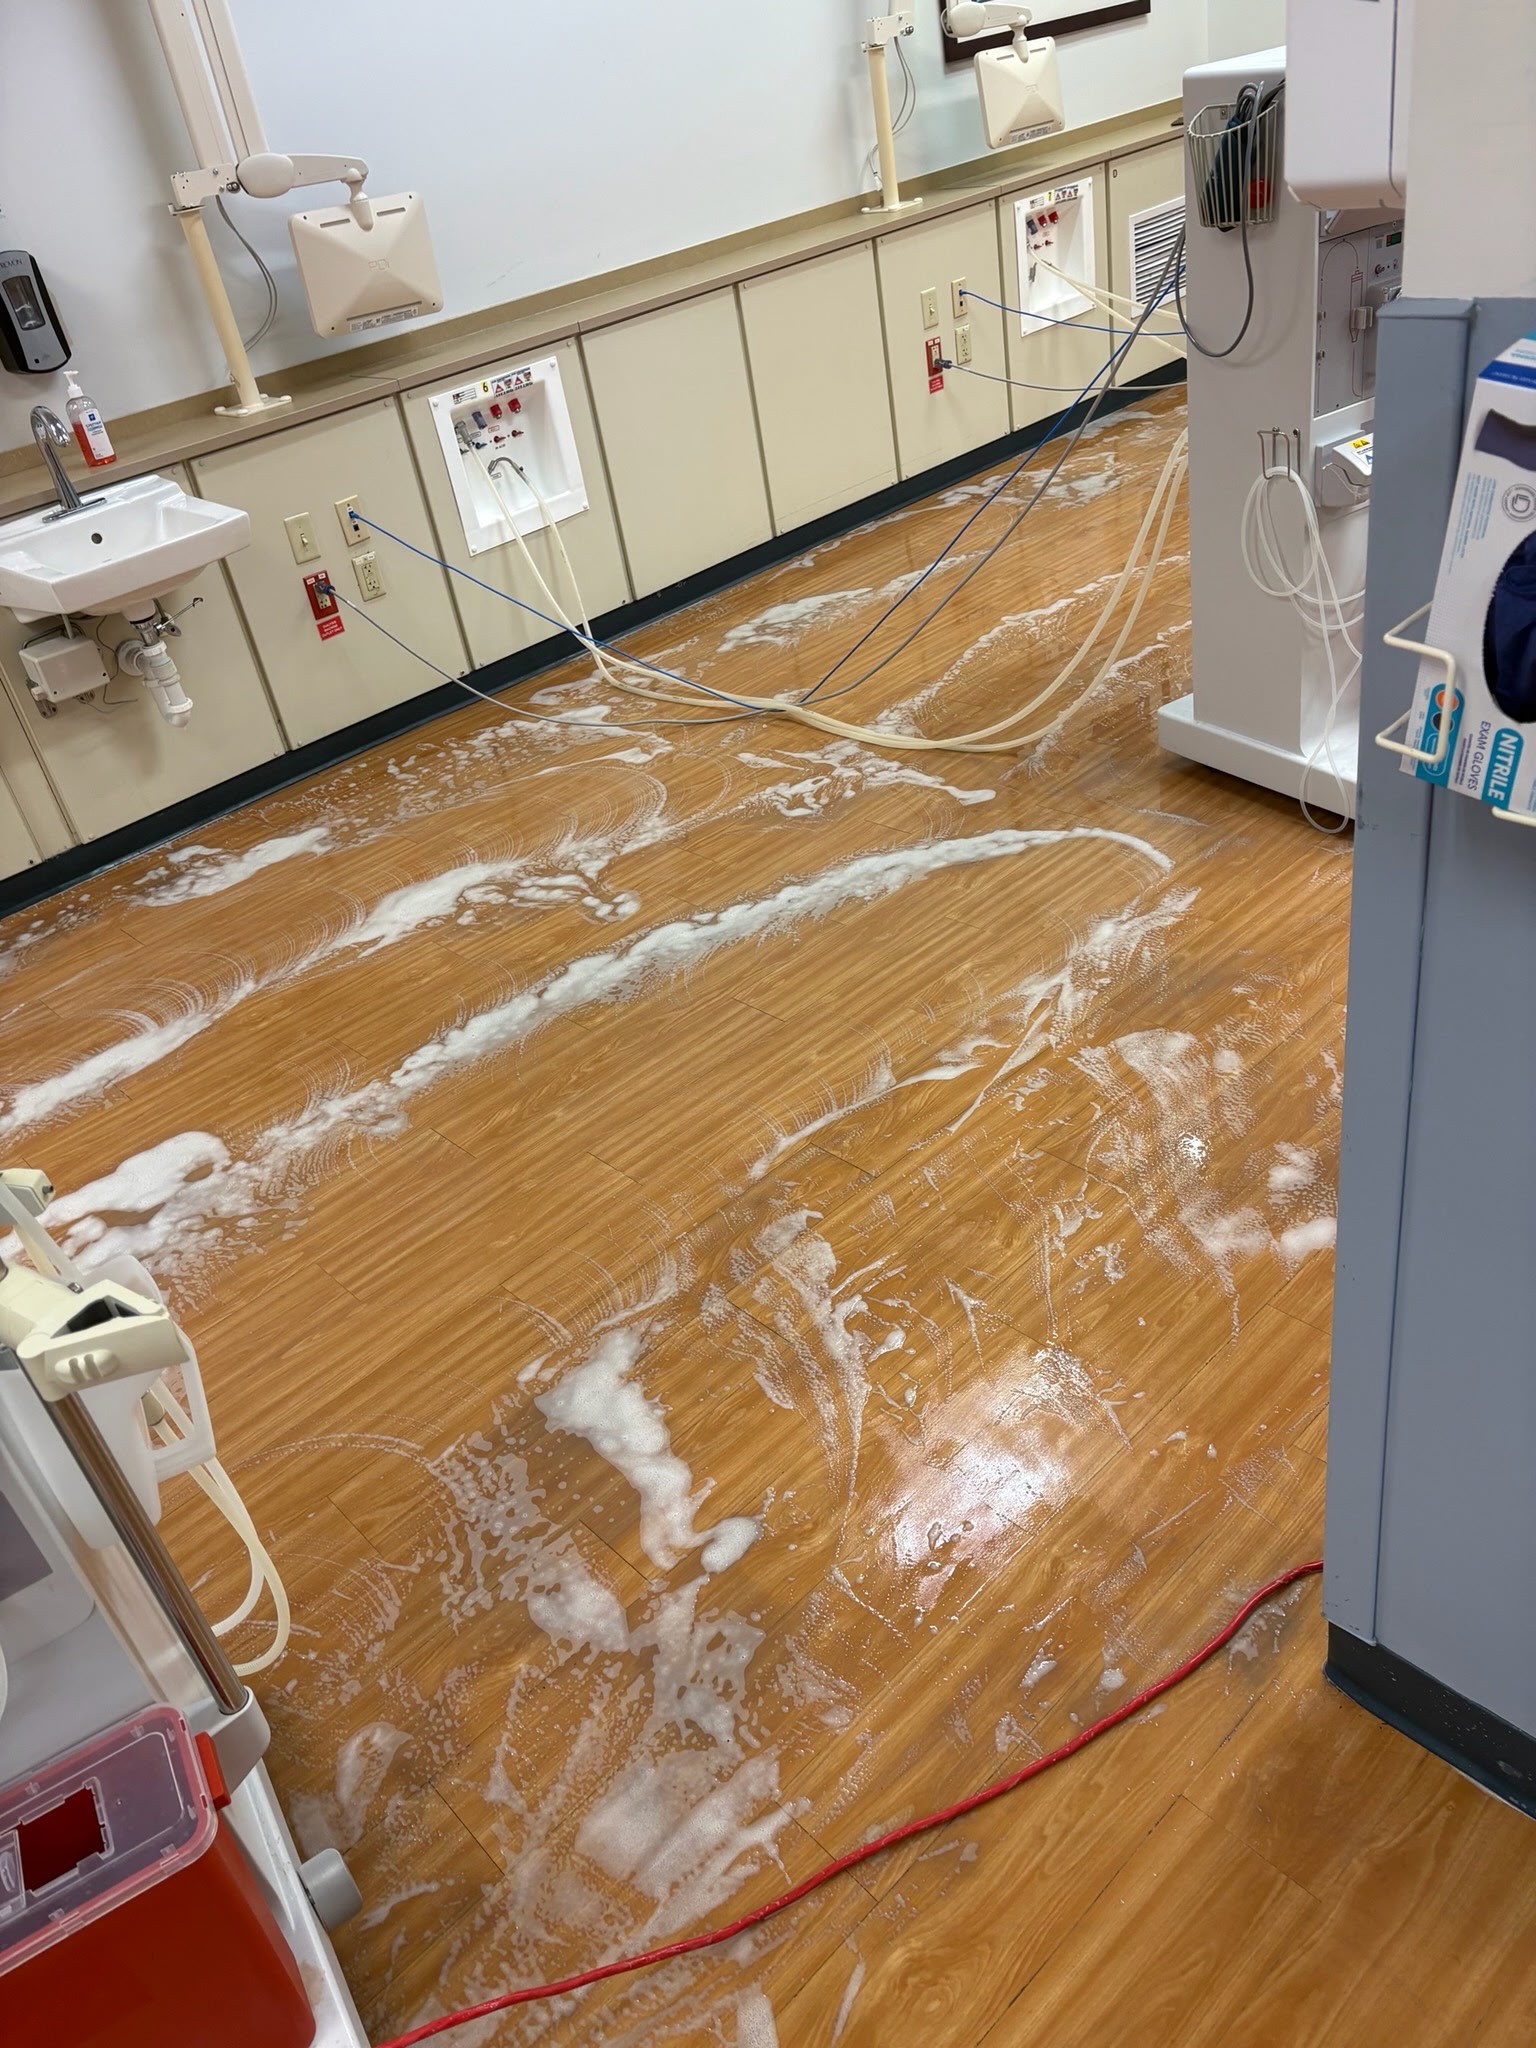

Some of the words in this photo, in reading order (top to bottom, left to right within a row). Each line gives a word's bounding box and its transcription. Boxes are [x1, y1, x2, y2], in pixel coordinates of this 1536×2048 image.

[482, 381, 489, 393] 6
[1476, 720, 1492, 751] EXAM
[1467, 751, 1485, 791] GLOVES
[1487, 732, 1519, 801] NITRILE
